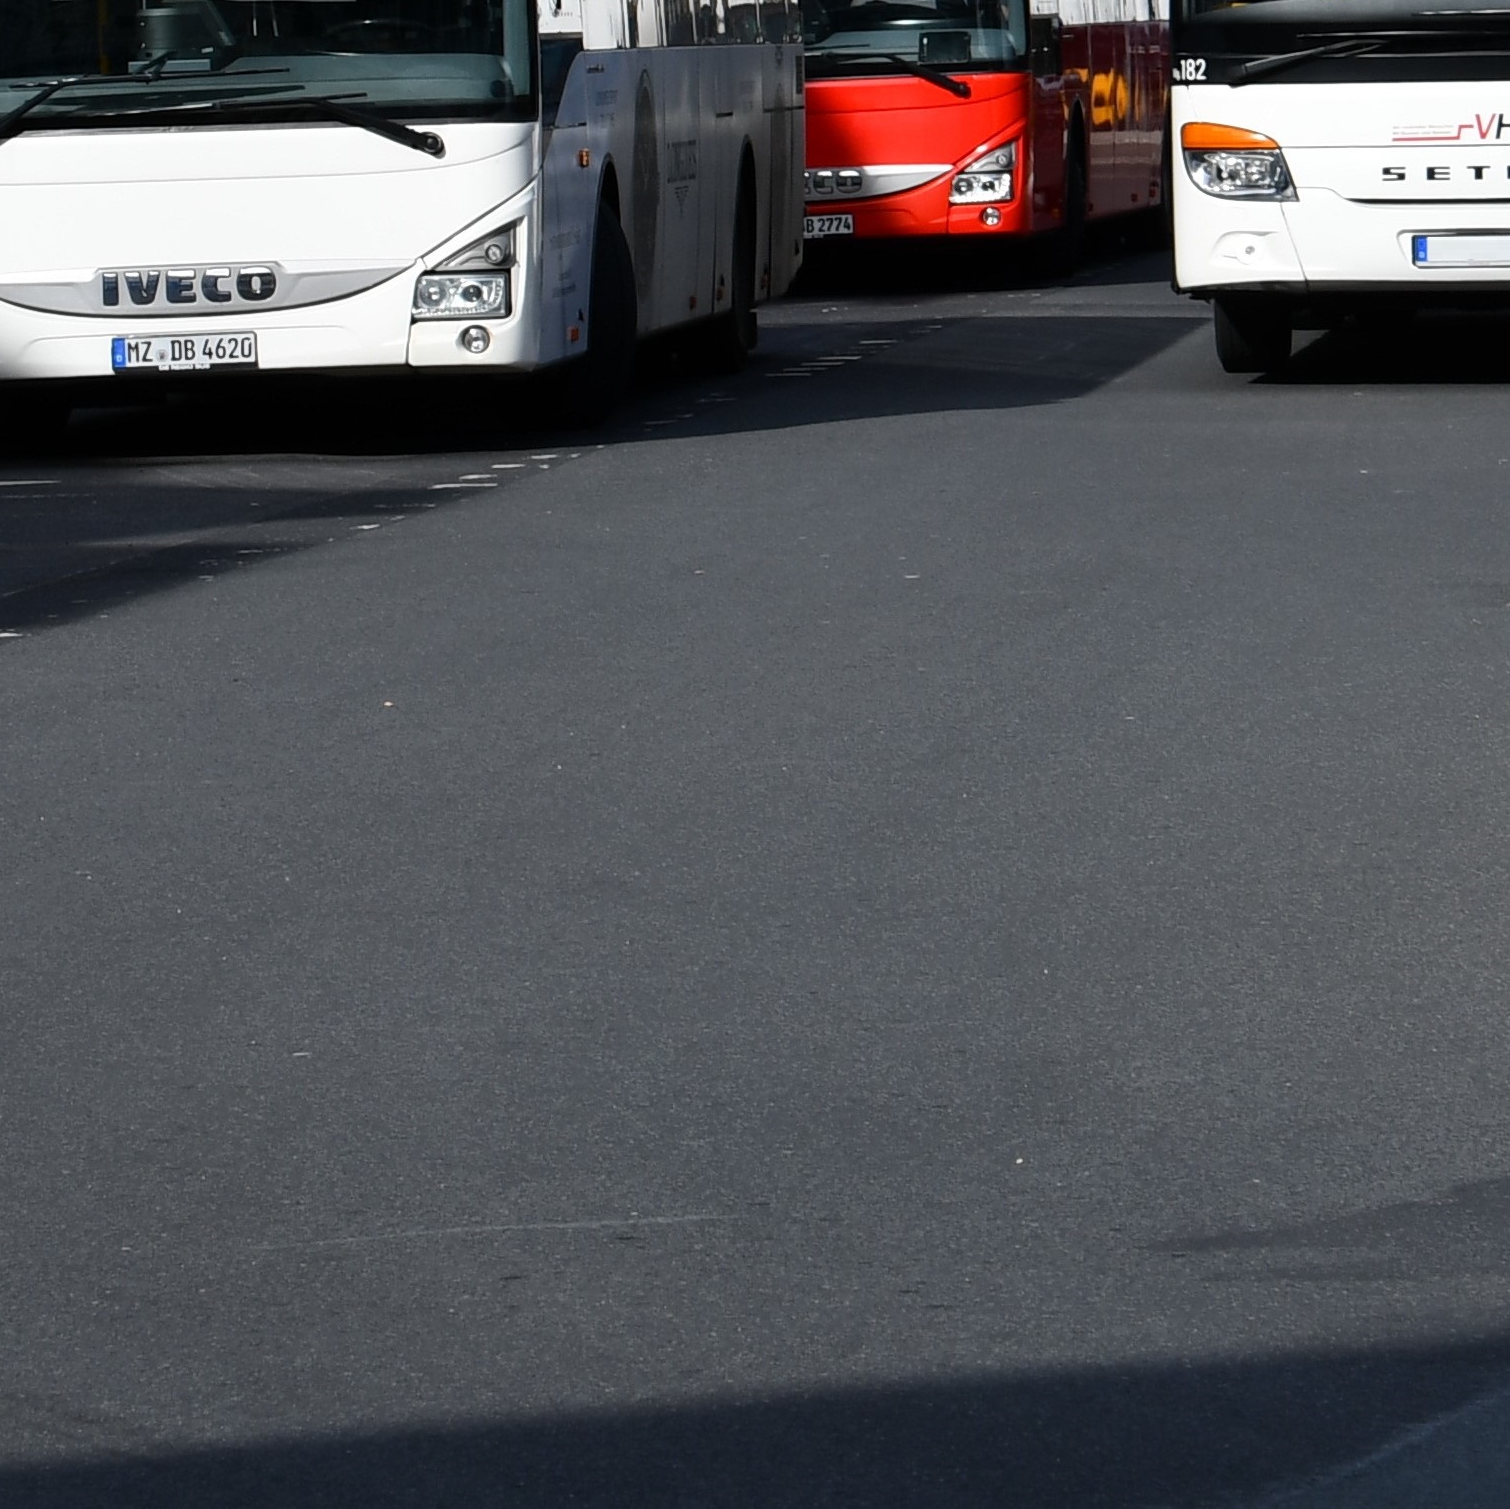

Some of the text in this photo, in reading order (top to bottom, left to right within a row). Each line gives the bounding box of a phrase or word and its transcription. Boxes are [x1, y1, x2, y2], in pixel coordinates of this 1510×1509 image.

[1180, 58, 1208, 81] 182
[803, 216, 852, 233] B 2774
[102, 265, 277, 307] IVECO
[127, 340, 153, 363] MZ
[170, 339, 196, 362] DB
[202, 337, 253, 360] 4620
